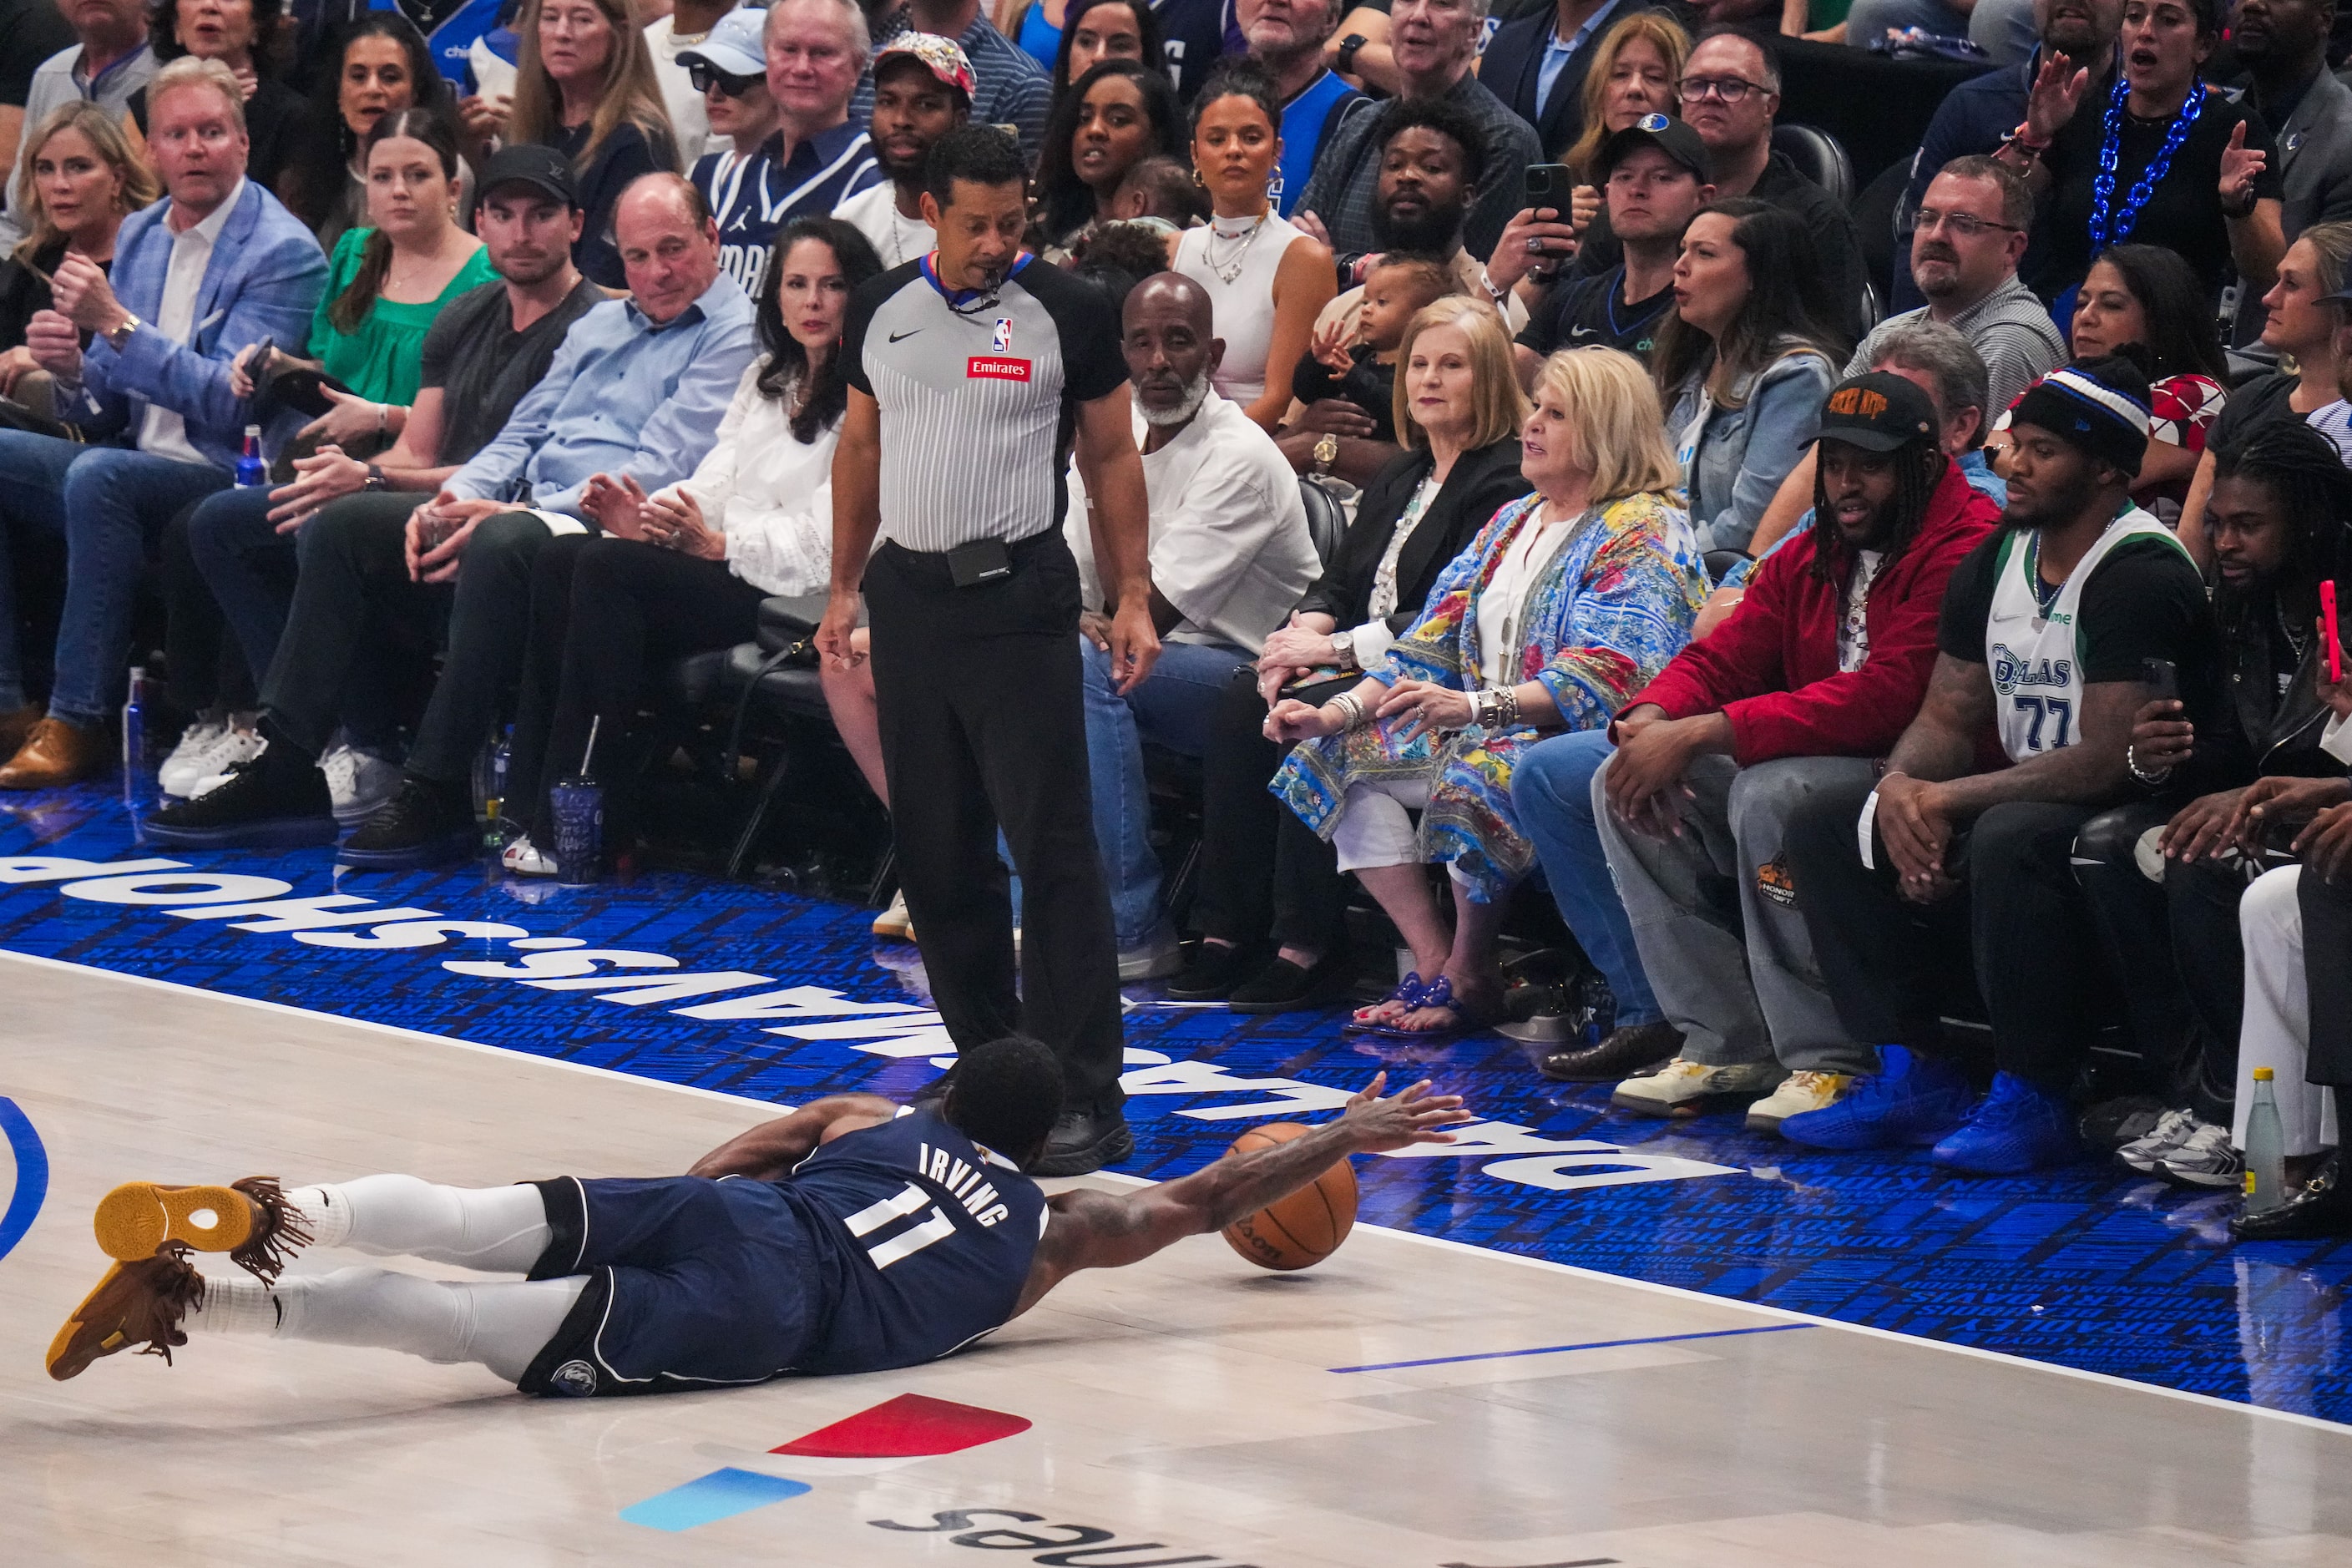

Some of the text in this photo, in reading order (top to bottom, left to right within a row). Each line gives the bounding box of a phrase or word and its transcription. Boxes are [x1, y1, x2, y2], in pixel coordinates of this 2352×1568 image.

[443, 44, 470, 58] chi
[973, 362, 1025, 375] Emirates
[2013, 695, 2073, 751] 77
[1763, 883, 1795, 898] HONOR
[79, 948, 387, 961] GREG BUCKNER
[336, 1002, 646, 1019] JASON TERRY
[457, 1025, 703, 1040] ROLANDO
[918, 1142, 1009, 1227] IRVING
[1800, 1176, 1932, 1191] KIDD
[1504, 1198, 1859, 1216] DWIGHT POWELL
[842, 1181, 957, 1271] 11
[1564, 1215, 1856, 1232] ROY TARPLEY
[1582, 1229, 1912, 1248] DONALD HODGE
[1488, 1242, 1686, 1253] ARMSTRONG
[2035, 1270, 2092, 1279] TIM
[1899, 1281, 2194, 1295] BRENDAN HAYWOOD
[1901, 1291, 2225, 1309] HUBERT DAVIS
[1946, 1318, 2177, 1335] BRADLEY
[1982, 1335, 2175, 1348] SCOTT LLOYD
[2054, 1348, 2193, 1358] BRISTOW
